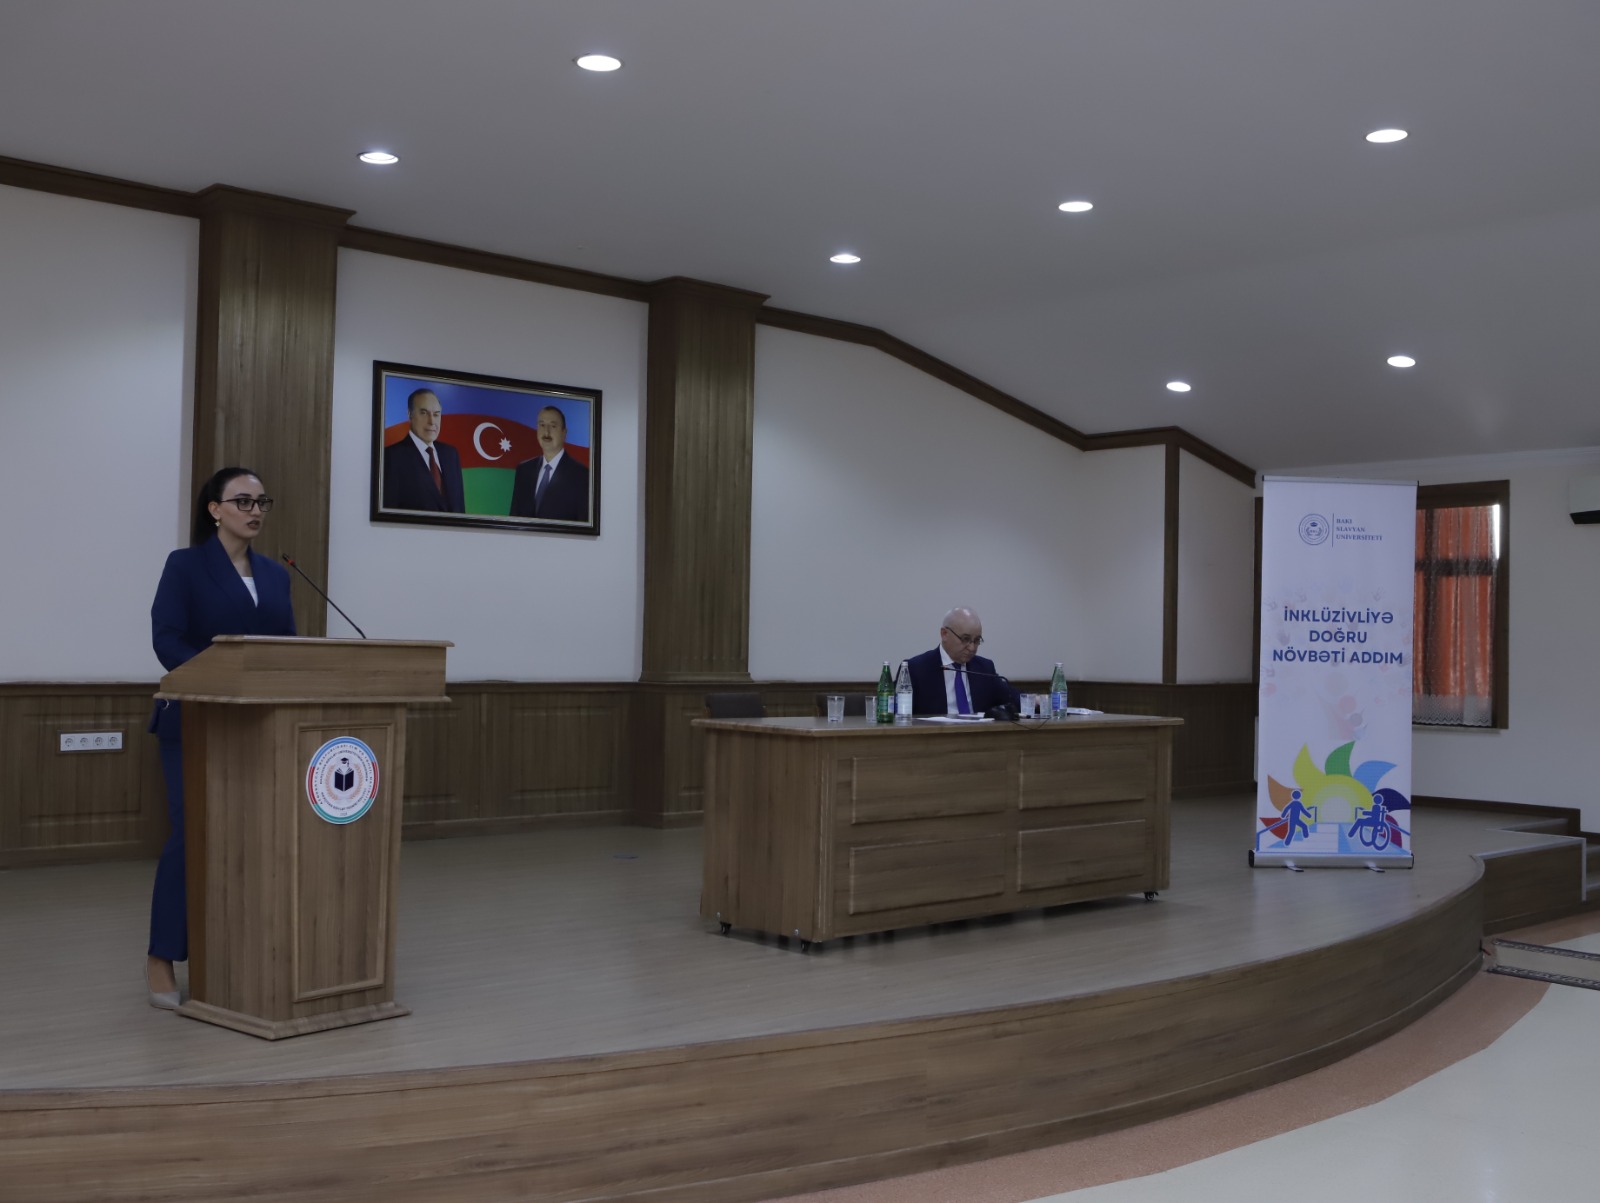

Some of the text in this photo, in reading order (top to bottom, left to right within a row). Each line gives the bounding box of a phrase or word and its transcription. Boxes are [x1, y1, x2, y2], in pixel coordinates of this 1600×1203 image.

[1284, 606, 1394, 624] İNKLÜZİVLİYƏ
[1309, 628, 1368, 643] DOĞRU
[1273, 646, 1403, 664] NÖVBƏTİ ADDIM
